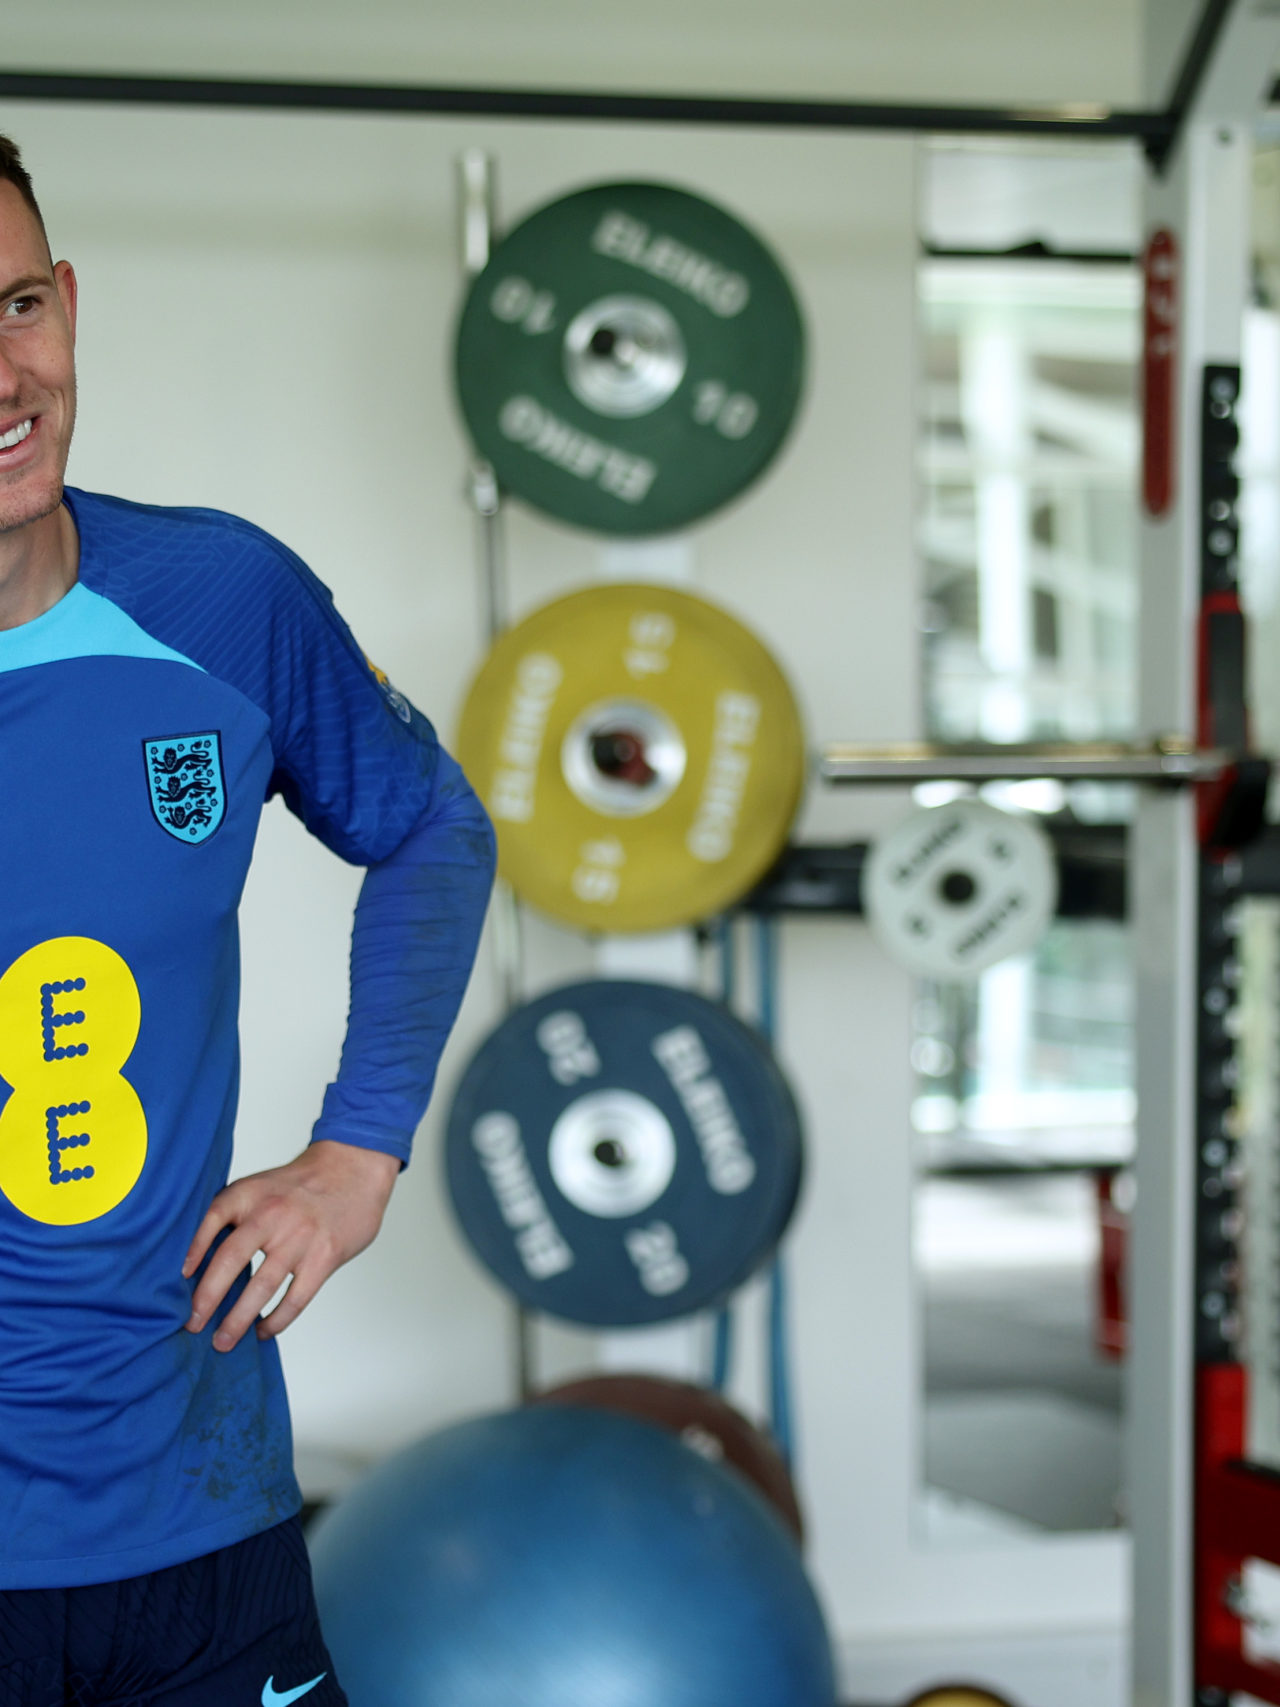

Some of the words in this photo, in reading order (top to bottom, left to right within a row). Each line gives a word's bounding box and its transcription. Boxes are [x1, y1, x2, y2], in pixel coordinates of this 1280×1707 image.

[590, 208, 750, 319] ELEIKO
[498, 394, 657, 505] ELEIKO
[685, 689, 762, 863] ELEIKO
[471, 1110, 575, 1281] ELEIKO
[651, 1024, 756, 1196] ELEIKO
